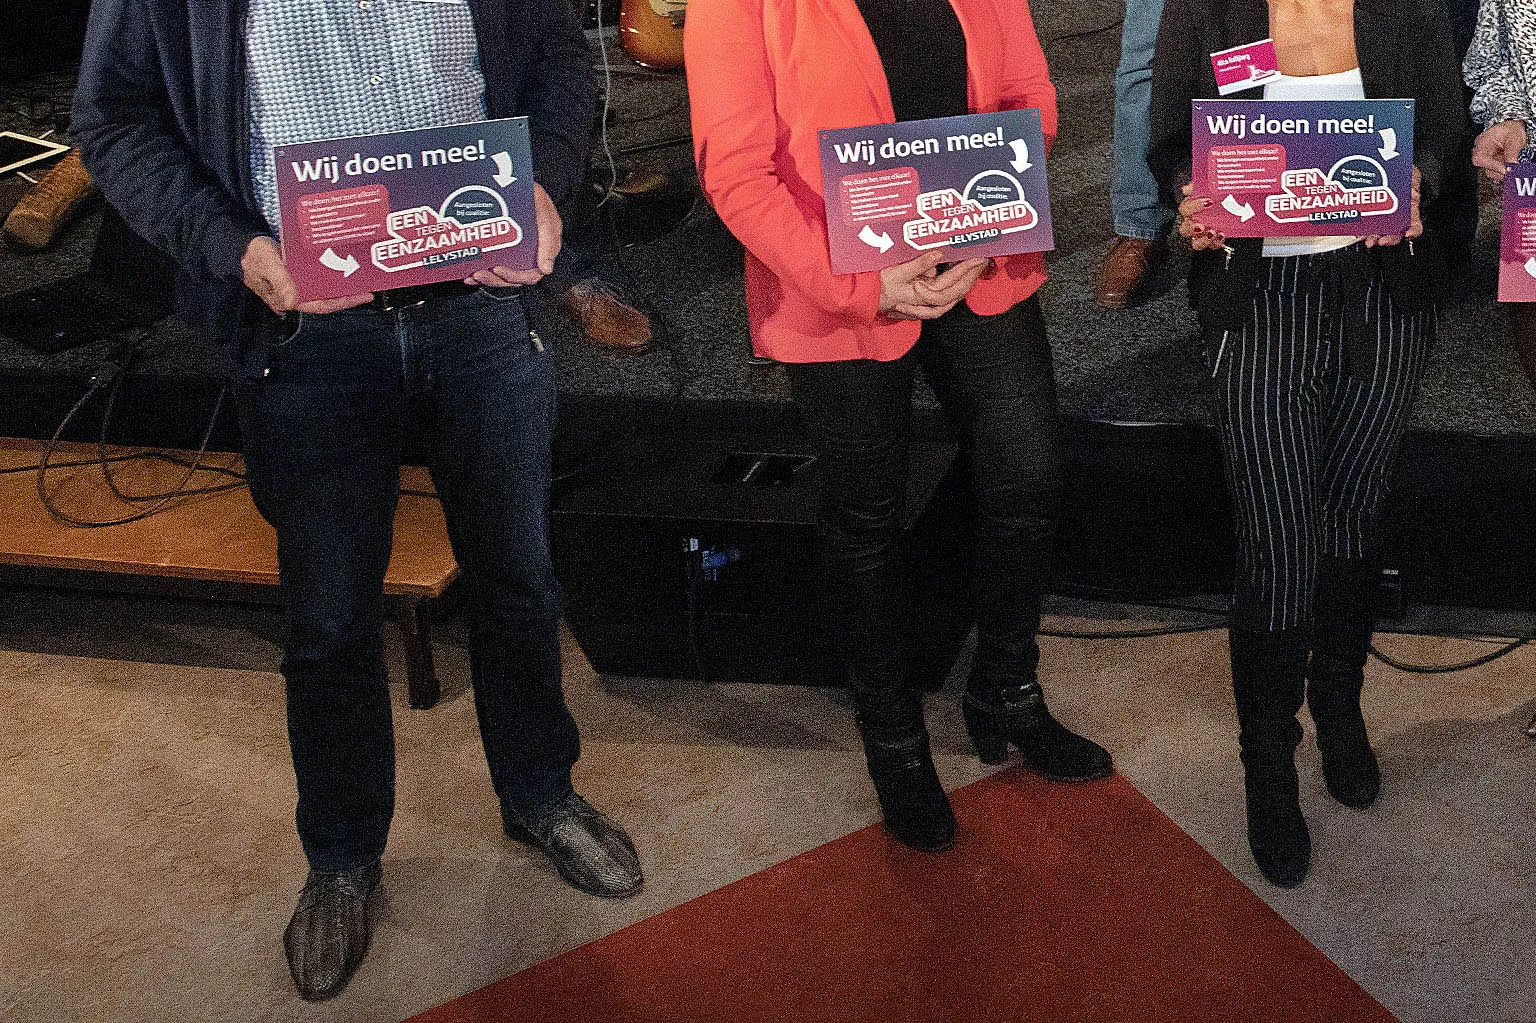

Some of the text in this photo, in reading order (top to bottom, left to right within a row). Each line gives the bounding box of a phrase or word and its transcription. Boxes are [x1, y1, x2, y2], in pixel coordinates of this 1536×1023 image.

[1206, 114, 1374, 139] Wij doen mee!
[834, 126, 1004, 165] Wij doen mee!
[292, 139, 487, 184] Wij doen mee!
[1284, 172, 1317, 187] EEN
[1305, 184, 1338, 195] TEGEN
[921, 193, 954, 212] EEN
[941, 203, 975, 217] TEGEN
[1269, 190, 1388, 212] EENZAAMHEID
[391, 210, 429, 231] EEN
[907, 203, 1027, 240] EENZAAMHEID
[1309, 210, 1358, 221] LELYSTAD
[415, 221, 452, 237] TEGEN
[949, 228, 999, 245] LELYSTAD
[375, 220, 511, 261] EENZAAMHEID
[423, 246, 479, 266] LELYSTAD
